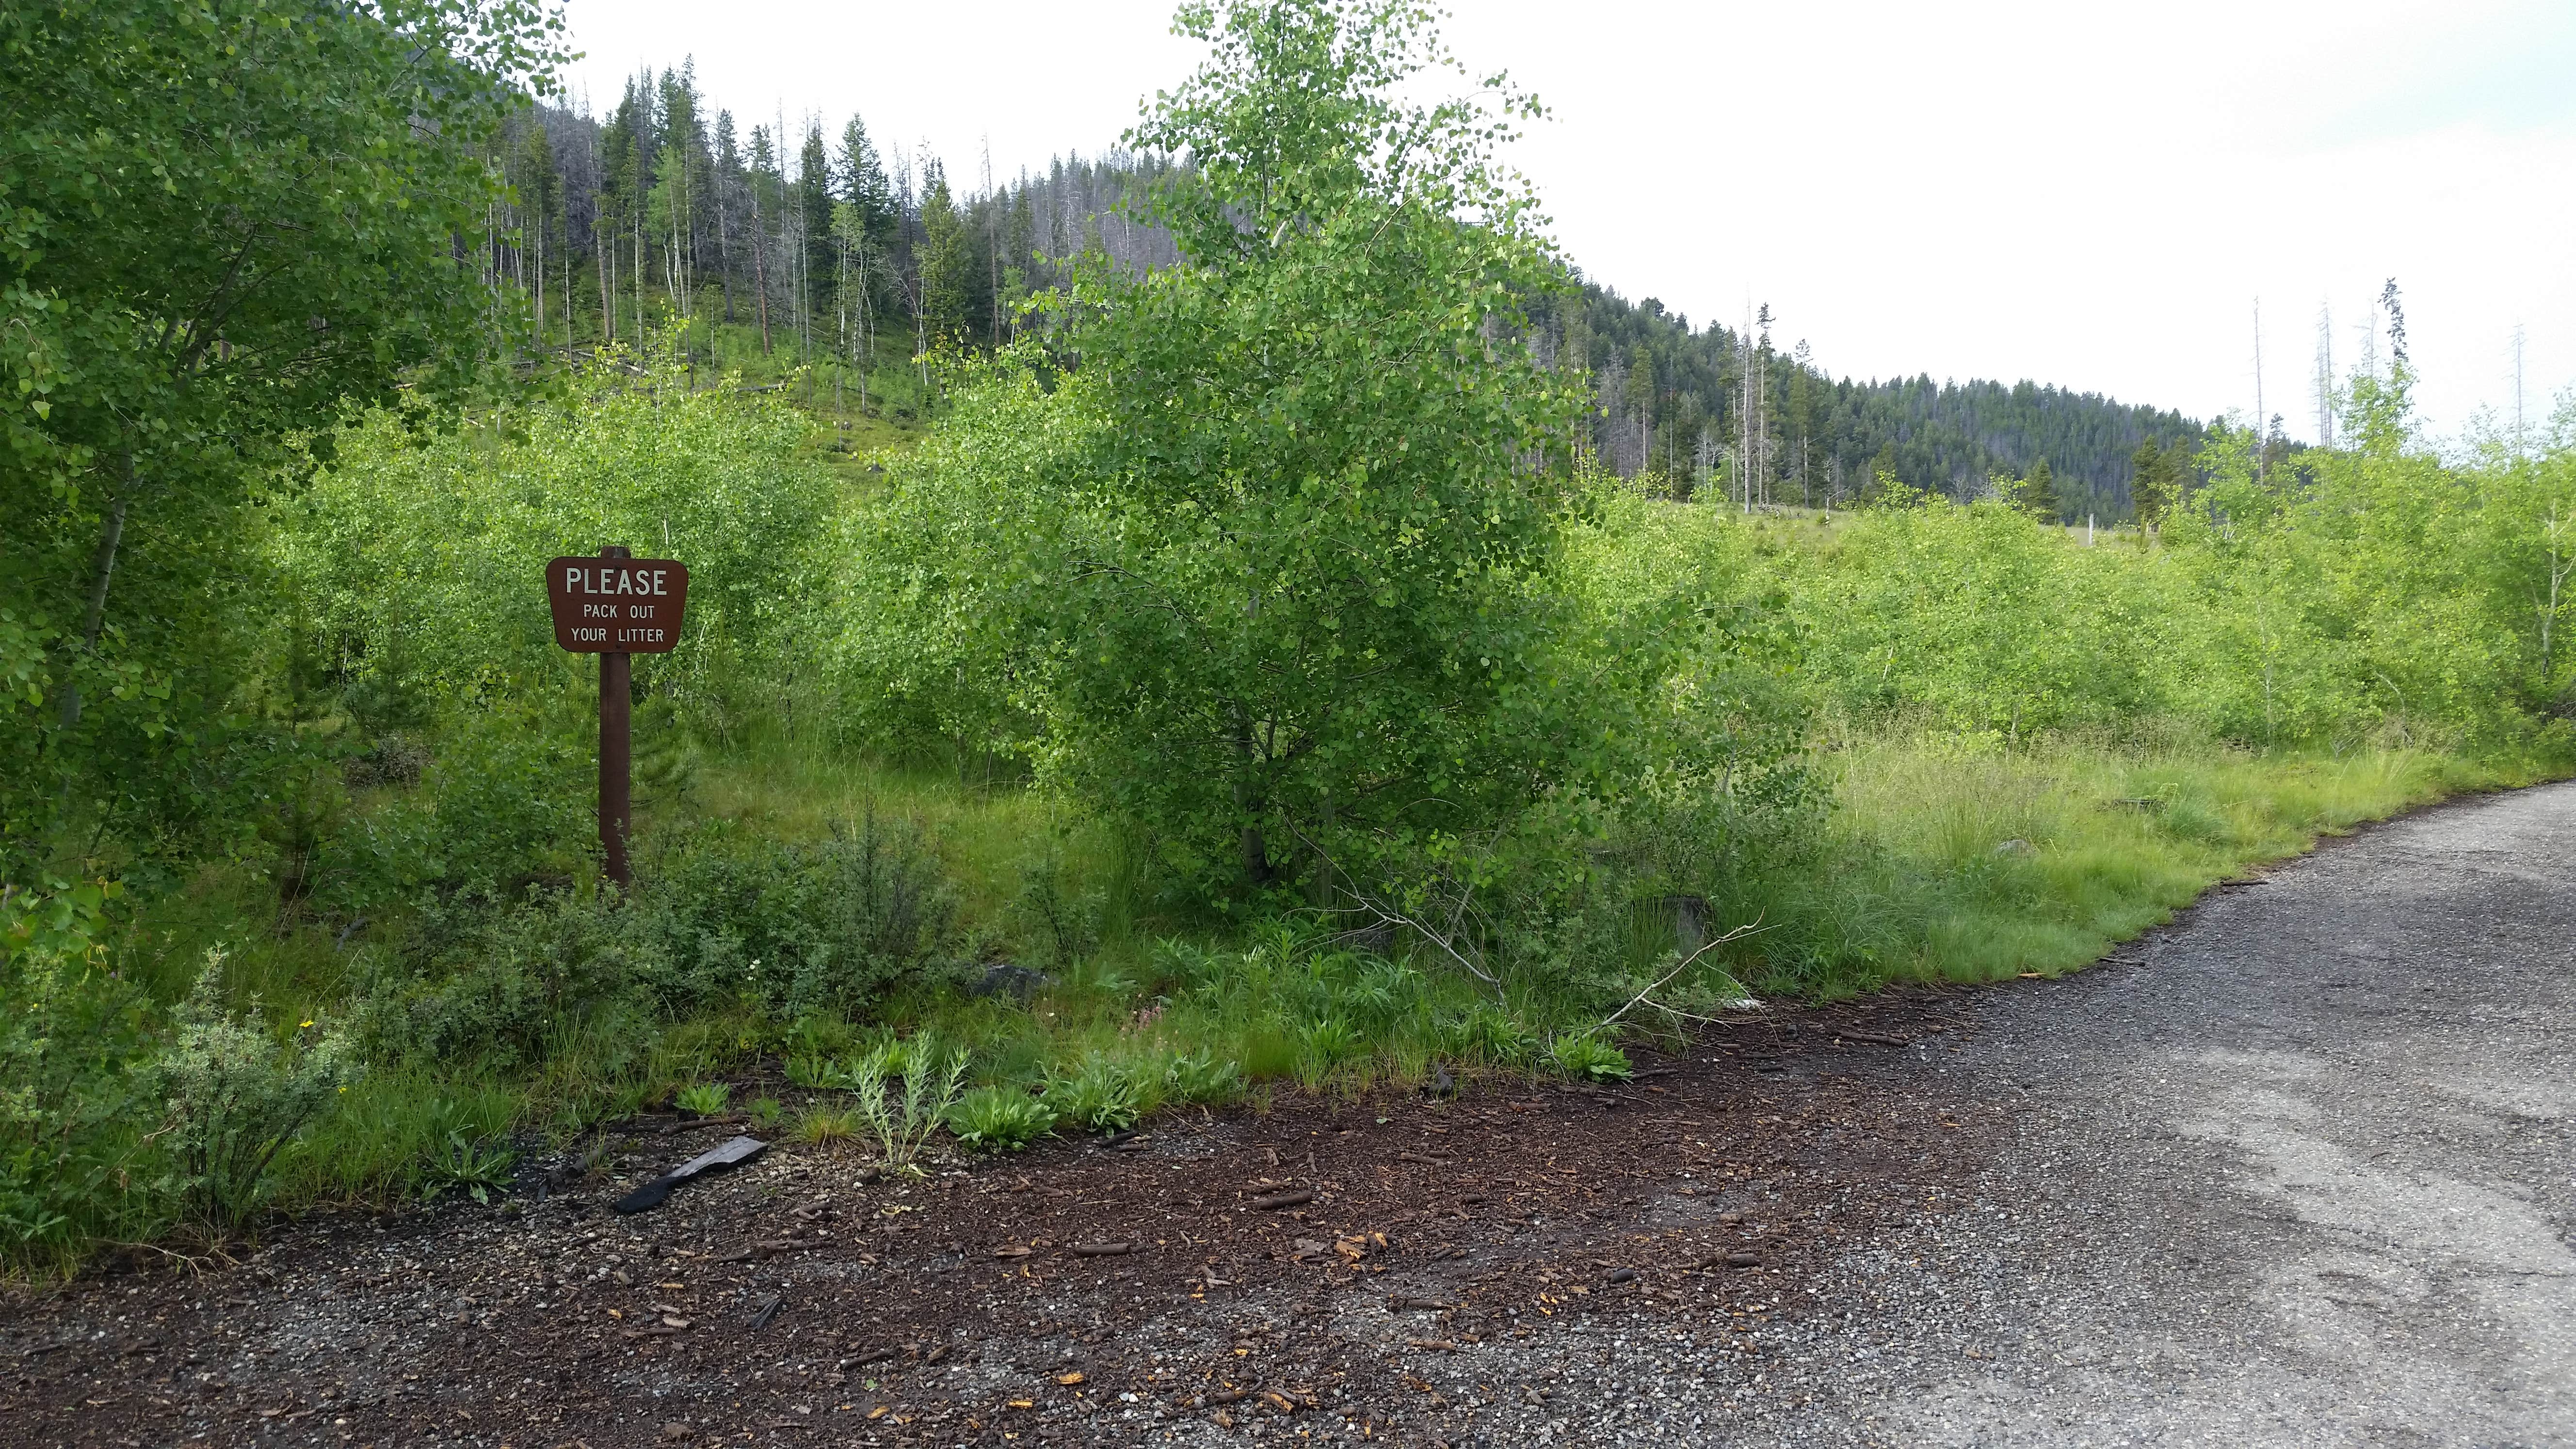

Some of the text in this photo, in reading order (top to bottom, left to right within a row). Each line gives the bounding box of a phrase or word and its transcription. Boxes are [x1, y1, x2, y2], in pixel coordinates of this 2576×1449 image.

[566, 568, 667, 595] PLEASE
[584, 604, 654, 618] PACK OUT
[571, 628, 663, 642] YOUR LITTER
